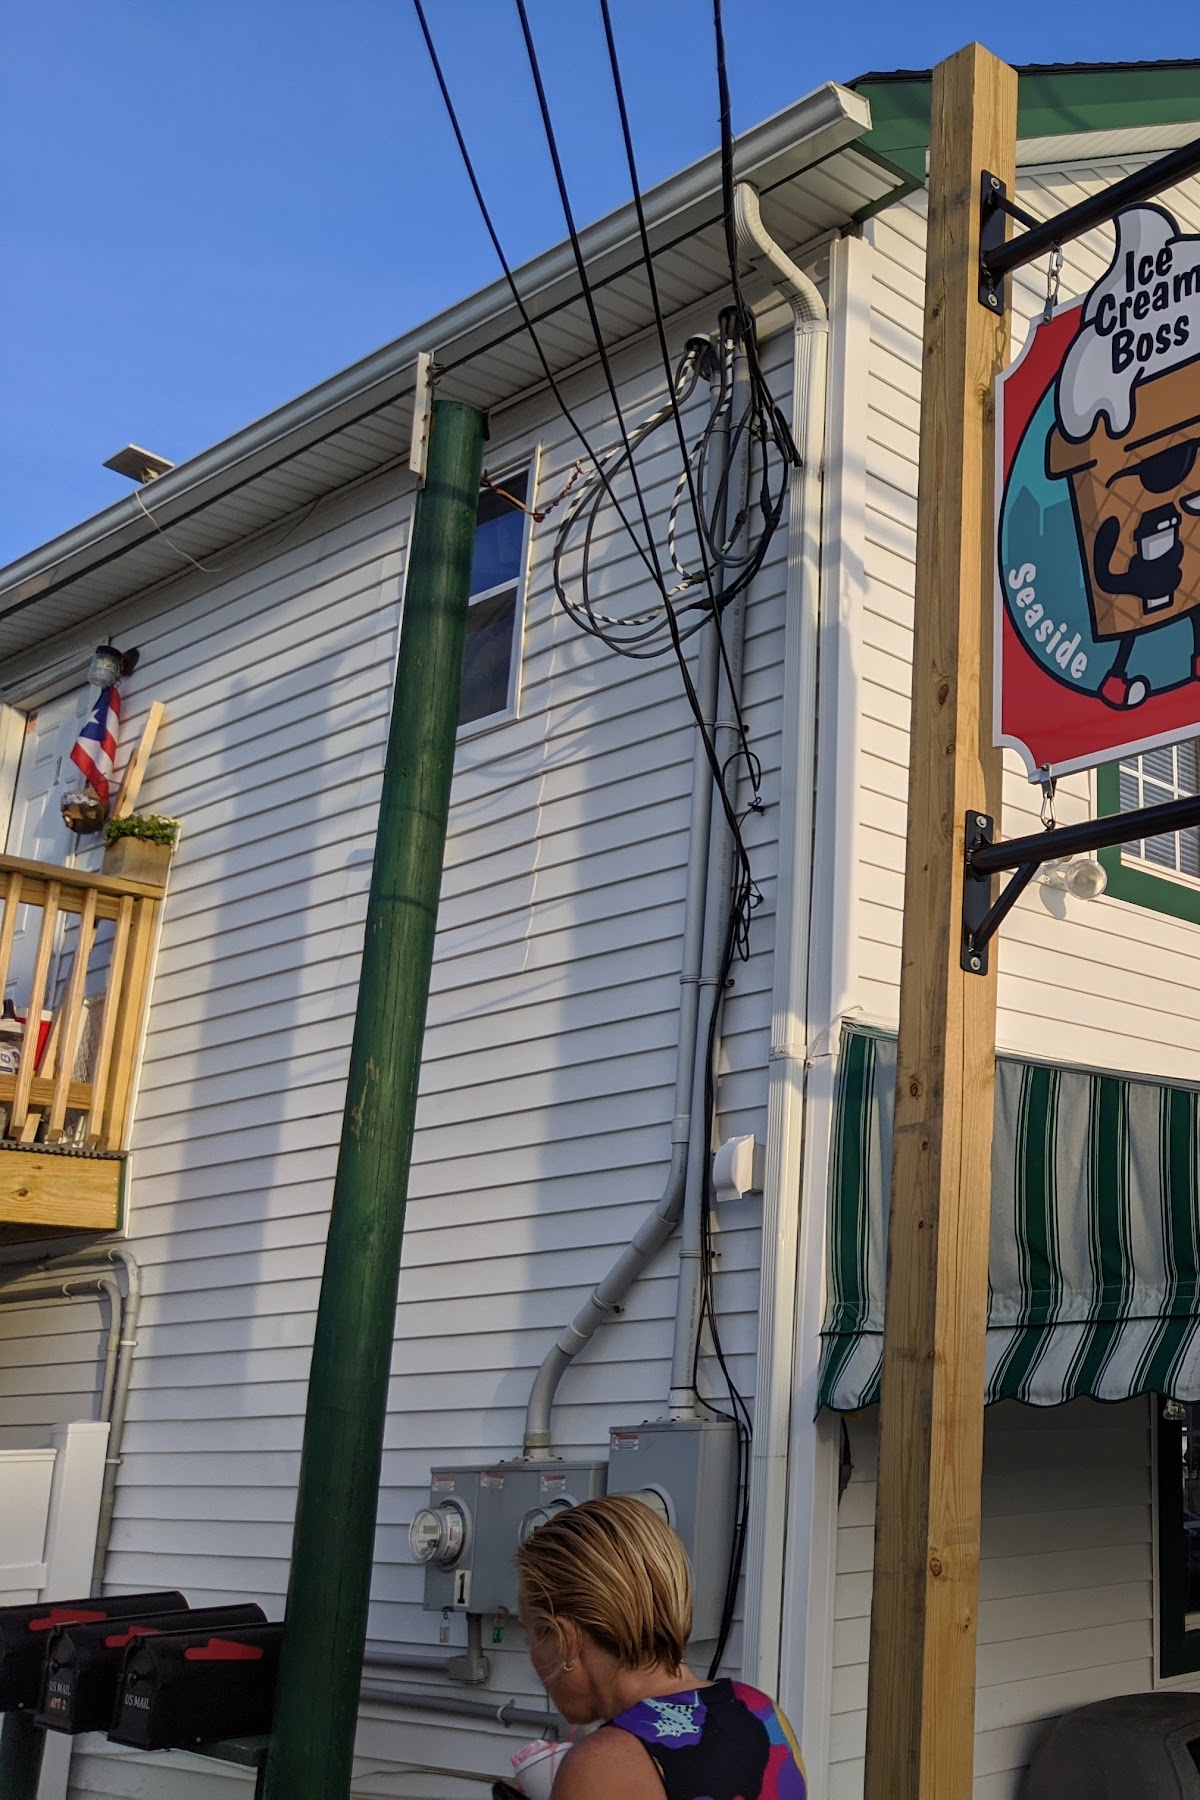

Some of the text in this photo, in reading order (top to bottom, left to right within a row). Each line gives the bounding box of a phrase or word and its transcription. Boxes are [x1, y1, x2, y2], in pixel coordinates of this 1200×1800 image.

[1126, 246, 1173, 293] Ice
[1112, 315, 1189, 374] Boss
[1009, 563, 1087, 678] Seaside
[457, 1572, 466, 1604] 1
[57, 1684, 72, 1696] MAIL
[124, 1694, 150, 1710] US MAIL
